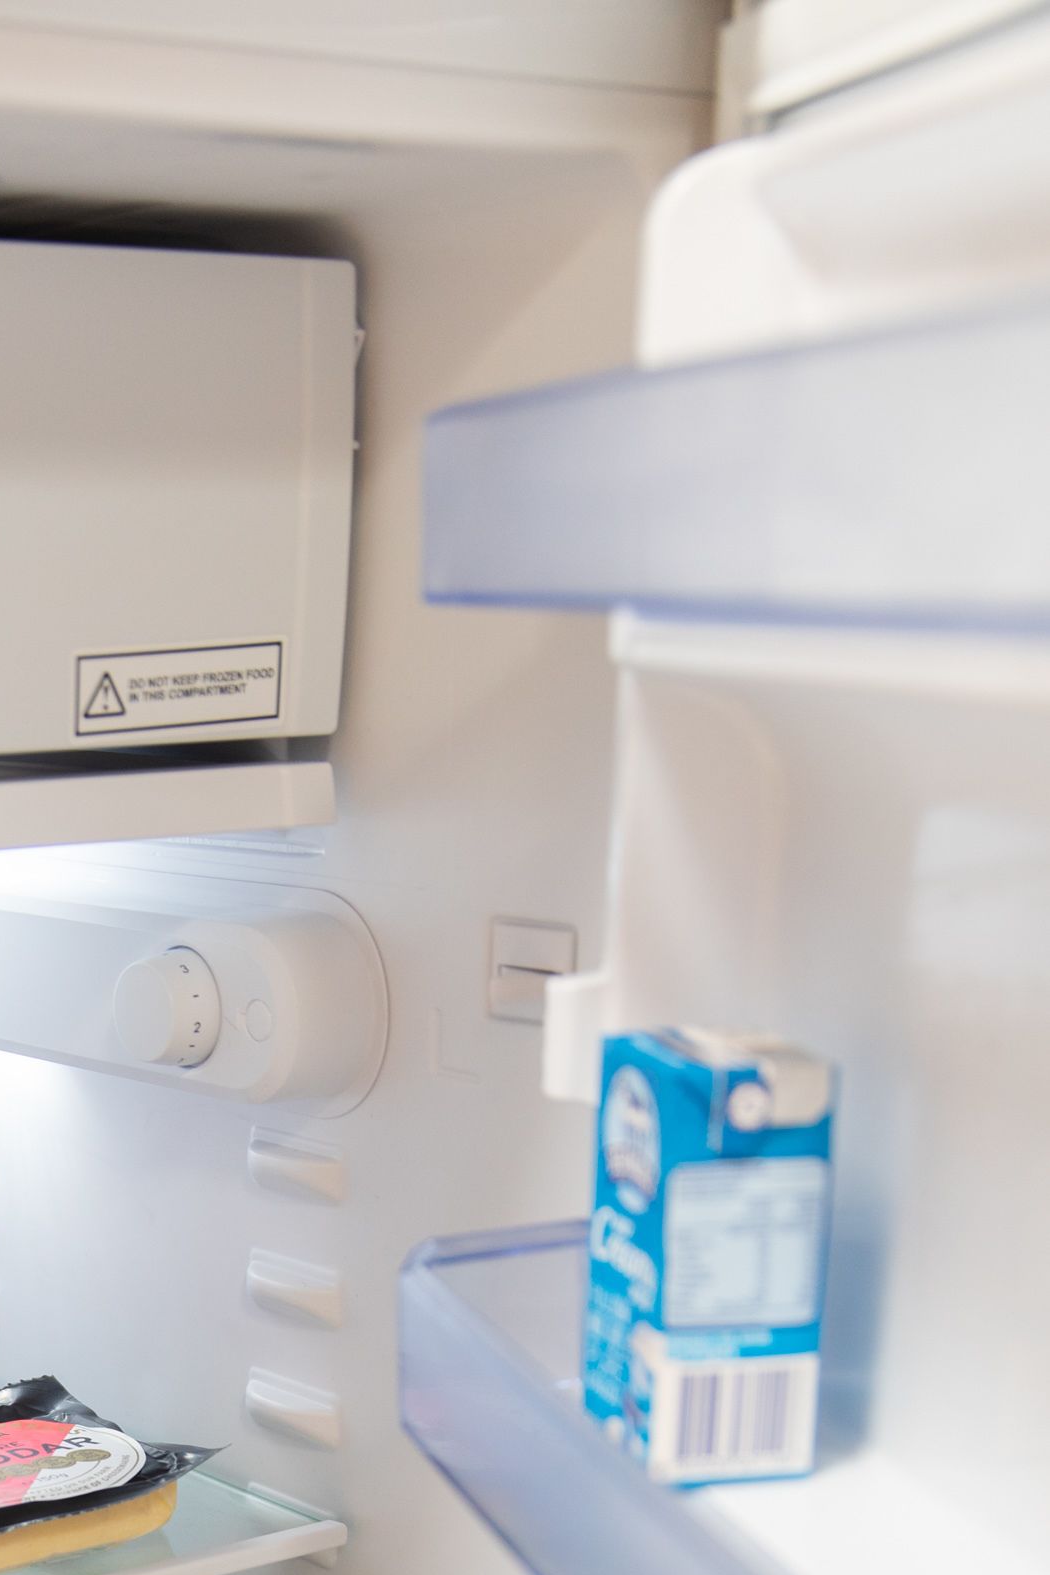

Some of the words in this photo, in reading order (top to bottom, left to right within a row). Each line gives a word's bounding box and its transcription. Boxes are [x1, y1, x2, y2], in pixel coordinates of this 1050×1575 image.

[129, 678, 146, 689] DO
[148, 676, 168, 687] NOT
[172, 674, 200, 685] KEEP
[202, 671, 244, 682] FROZEN
[246, 667, 275, 679] FOOD
[129, 692, 140, 701] IN
[142, 690, 165, 700] THIS
[168, 683, 247, 699] COMPARTMENT
[179, 963, 190, 974] 3
[193, 1021, 201, 1034] 2
